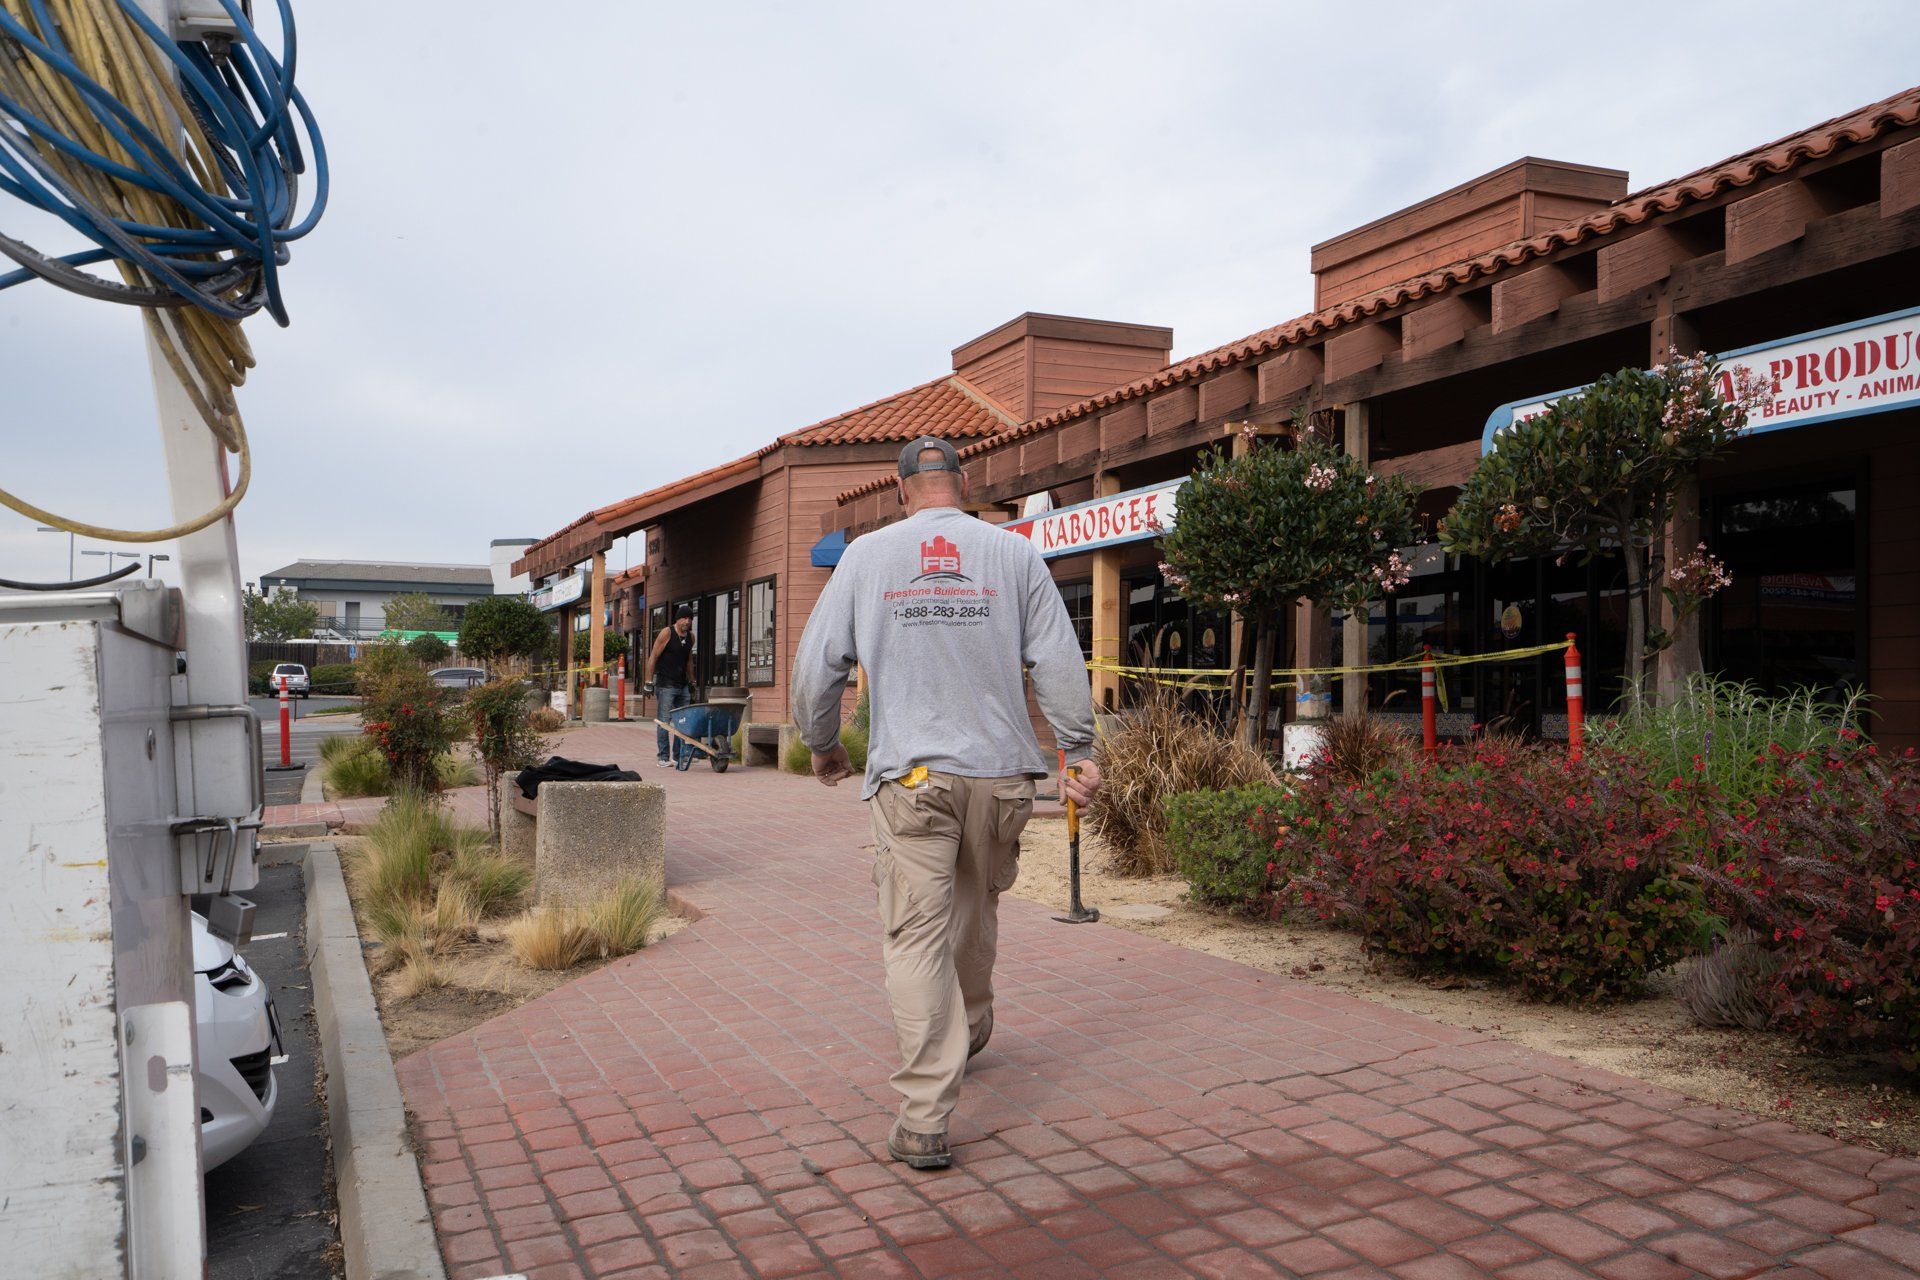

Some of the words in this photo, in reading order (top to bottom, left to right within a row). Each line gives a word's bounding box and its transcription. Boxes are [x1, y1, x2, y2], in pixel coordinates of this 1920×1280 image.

[1769, 331, 1920, 394] PRODUC
[1763, 389, 1840, 418] BEAUTY
[1042, 494, 1158, 550] KABOBGEE
[922, 556, 960, 571] FB
[883, 587, 931, 600] Firestone
[934, 586, 979, 598] Builders,
[981, 586, 999, 597] Inc.
[894, 605, 990, 620] 1-888-283-2843
